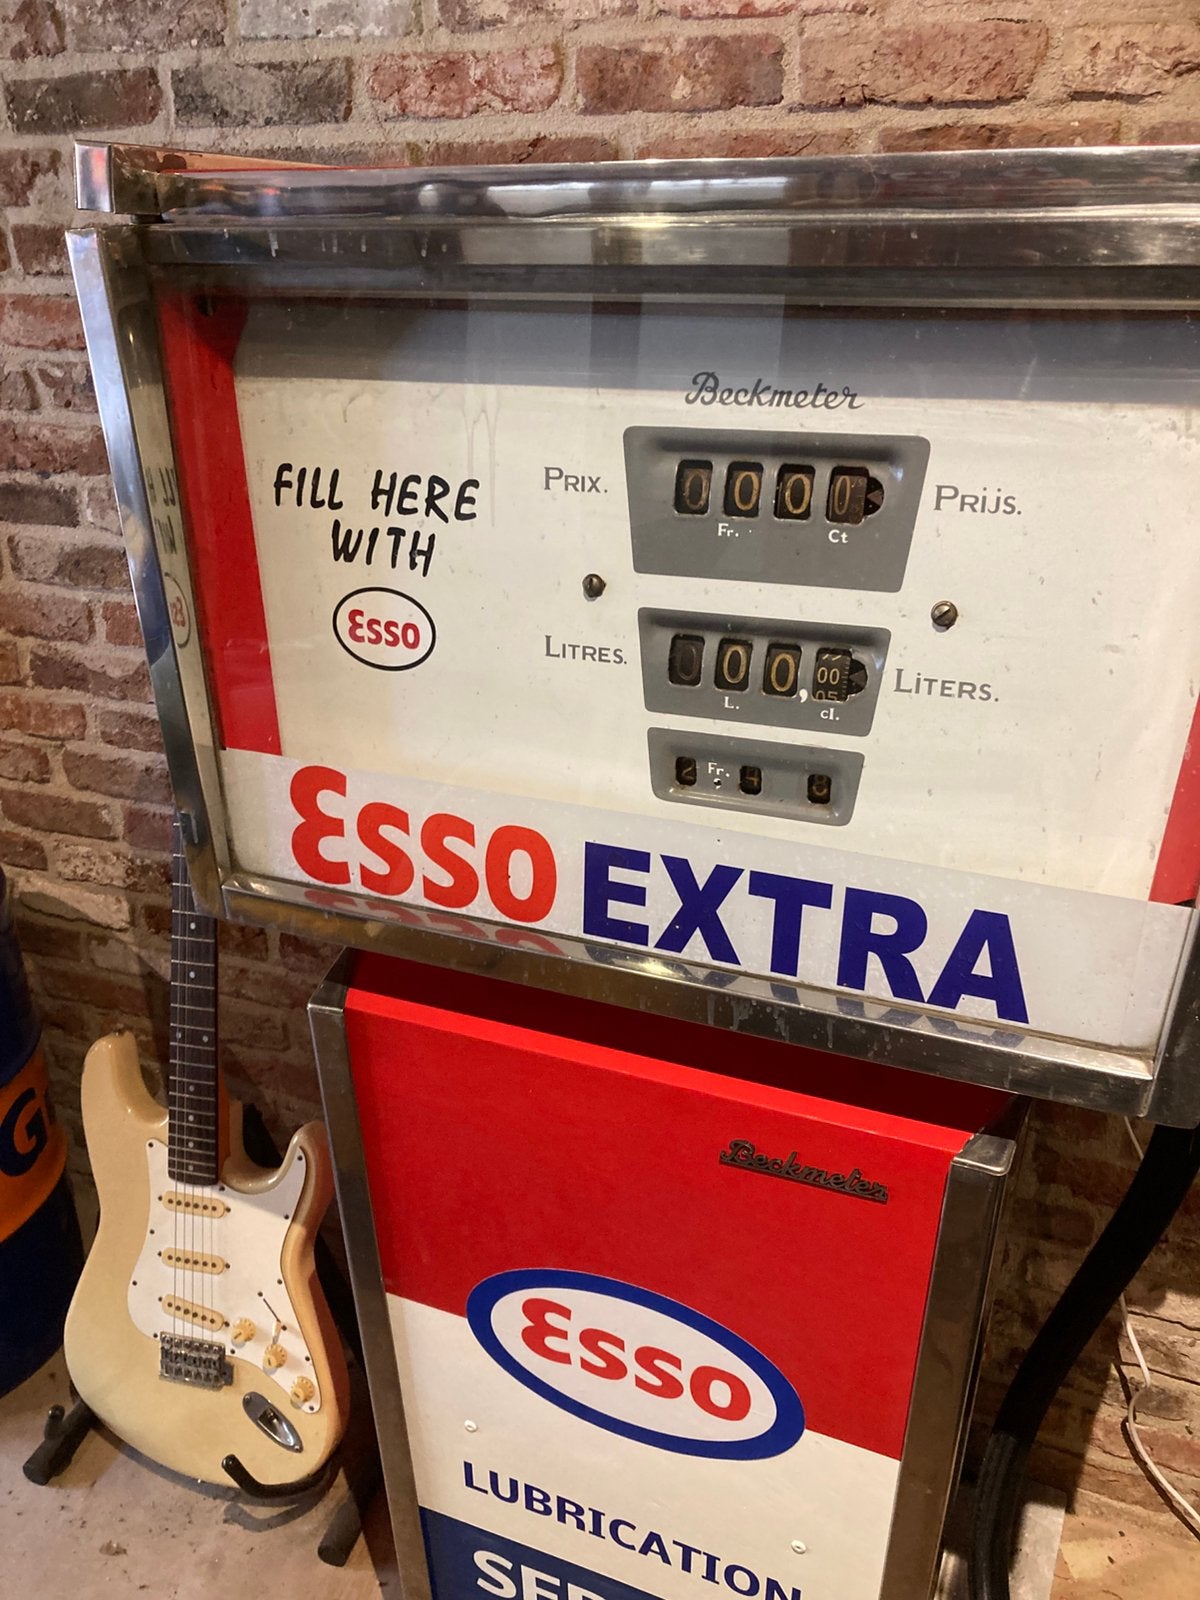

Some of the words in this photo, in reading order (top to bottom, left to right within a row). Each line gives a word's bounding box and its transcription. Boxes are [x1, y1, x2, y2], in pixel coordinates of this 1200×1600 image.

[684, 371, 865, 409] Beckmeter
[273, 463, 343, 510] FILL
[371, 469, 480, 523] HERE
[331, 519, 436, 577] WITH
[582, 841, 1030, 1026] EXTRA
[719, 1138, 889, 1205] Beckmeter
[463, 1460, 802, 1600] LUBRICATION
